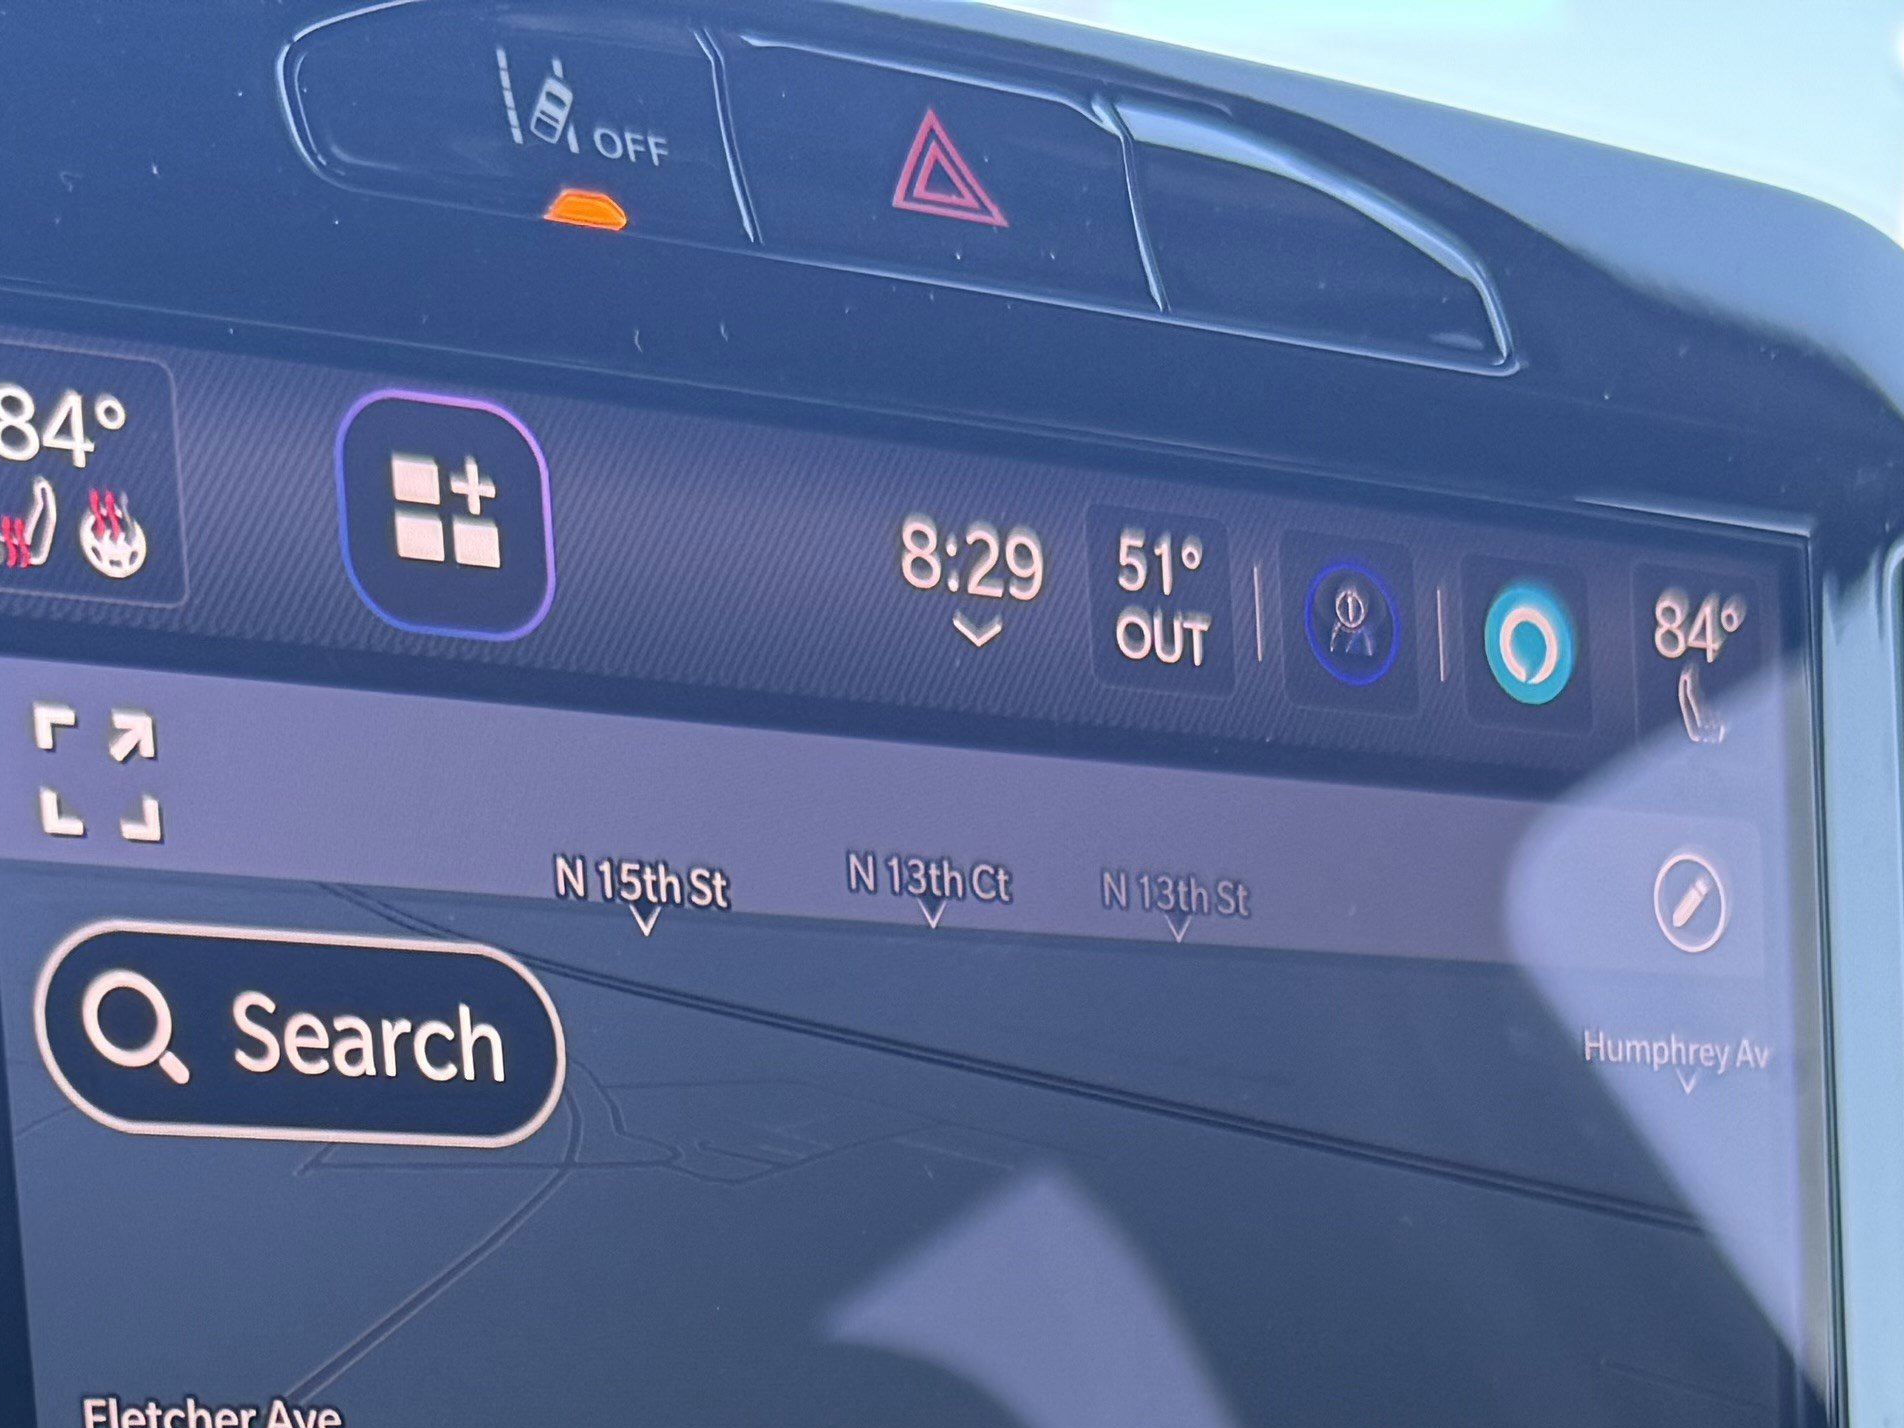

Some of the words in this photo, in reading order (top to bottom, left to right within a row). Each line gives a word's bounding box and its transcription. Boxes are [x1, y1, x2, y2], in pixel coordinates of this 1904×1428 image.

[594, 126, 669, 166] OFF
[901, 515, 1043, 600] 8:29
[1117, 527, 1203, 596] 51°
[1116, 607, 1211, 666] OUT
[1654, 588, 1744, 663] 84°
[555, 856, 585, 897] N
[598, 860, 681, 904] 15th
[690, 868, 728, 908] St
[848, 853, 875, 891] N
[887, 857, 963, 898] 13th
[971, 864, 1012, 902] Ct
[1103, 872, 1127, 909] N
[1139, 875, 1209, 915] 13th
[1218, 881, 1249, 917] St
[233, 989, 506, 1083] Search
[1584, 1030, 1729, 1075] Humphrey
[1736, 1038, 1769, 1069] Av
